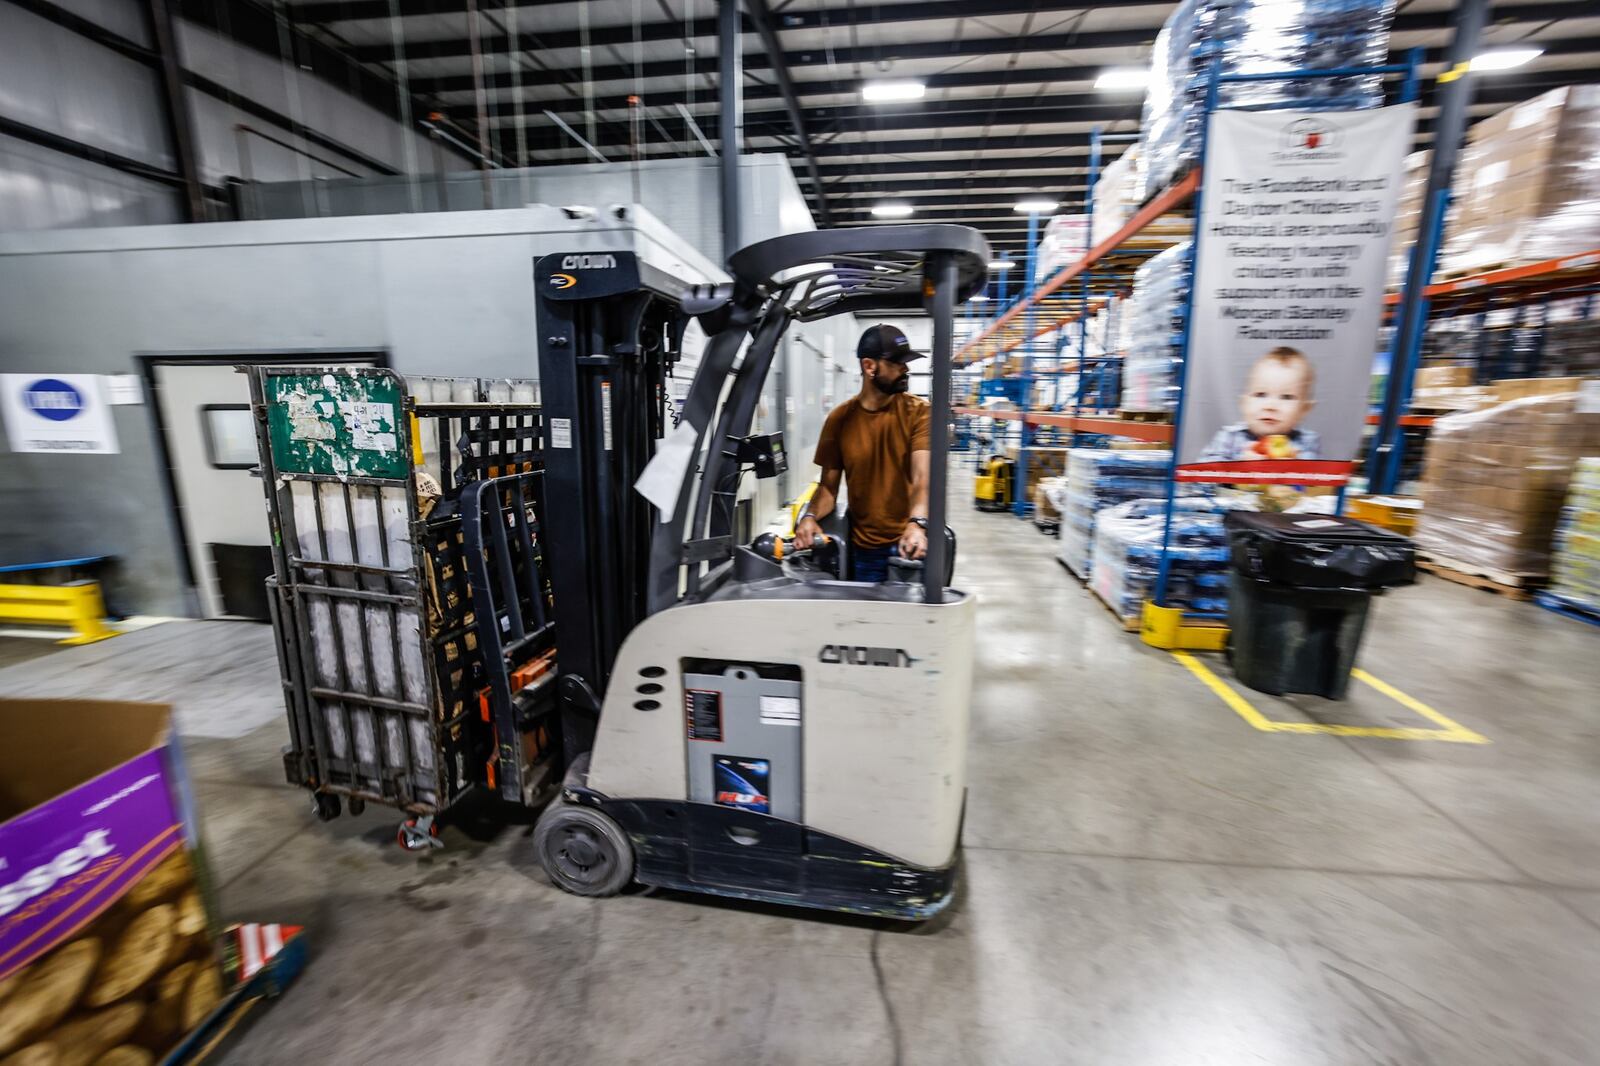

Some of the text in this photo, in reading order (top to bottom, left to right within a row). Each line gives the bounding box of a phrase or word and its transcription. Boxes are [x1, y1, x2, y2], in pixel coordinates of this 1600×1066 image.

[562, 254, 617, 269] CROWN
[1235, 325, 1335, 340] Foundation
[819, 645, 912, 667] CROWN
